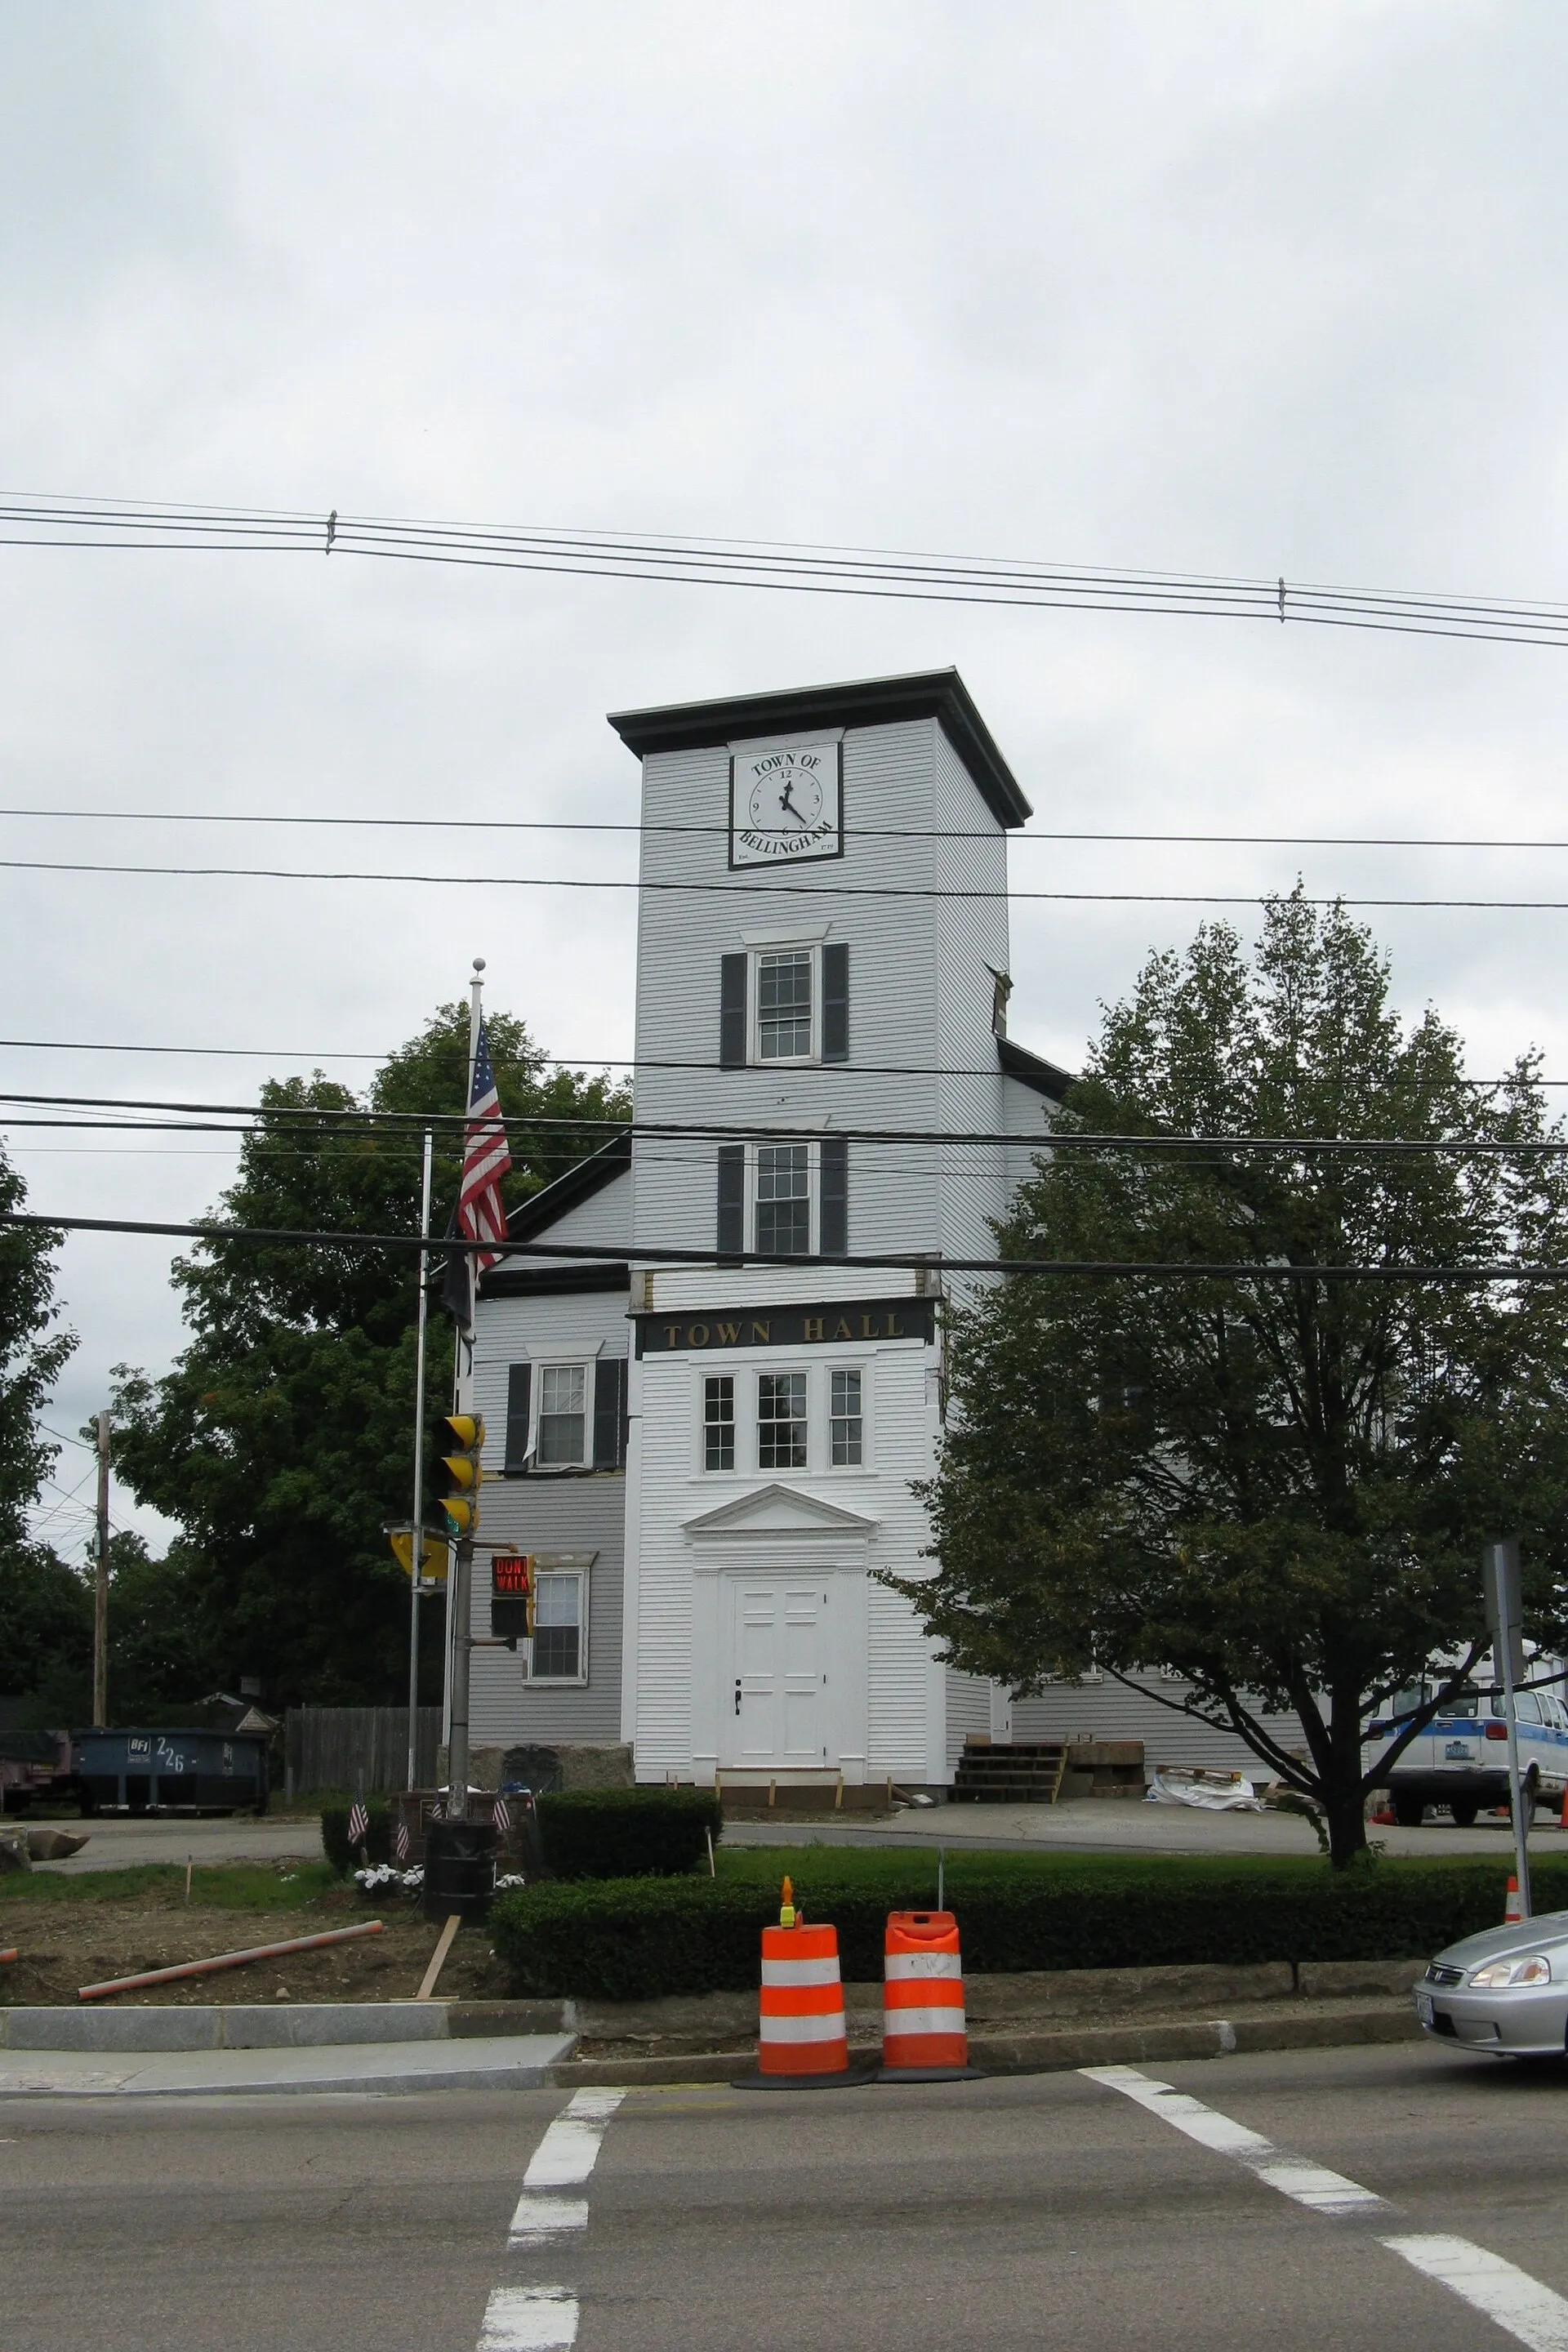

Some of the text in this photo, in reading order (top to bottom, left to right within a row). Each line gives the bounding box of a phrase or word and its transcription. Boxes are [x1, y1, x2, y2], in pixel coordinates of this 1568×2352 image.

[751, 753, 822, 777] TOWN OF
[780, 770, 792, 779] 12
[813, 795, 820, 804] 3
[752, 803, 760, 813] 9
[738, 820, 834, 854] BELLINGHAM
[664, 1313, 905, 1348] TOWN HALL
[497, 1575, 528, 1591] WALK
[131, 1739, 149, 1753] BFI
[157, 1736, 185, 1772] 226
